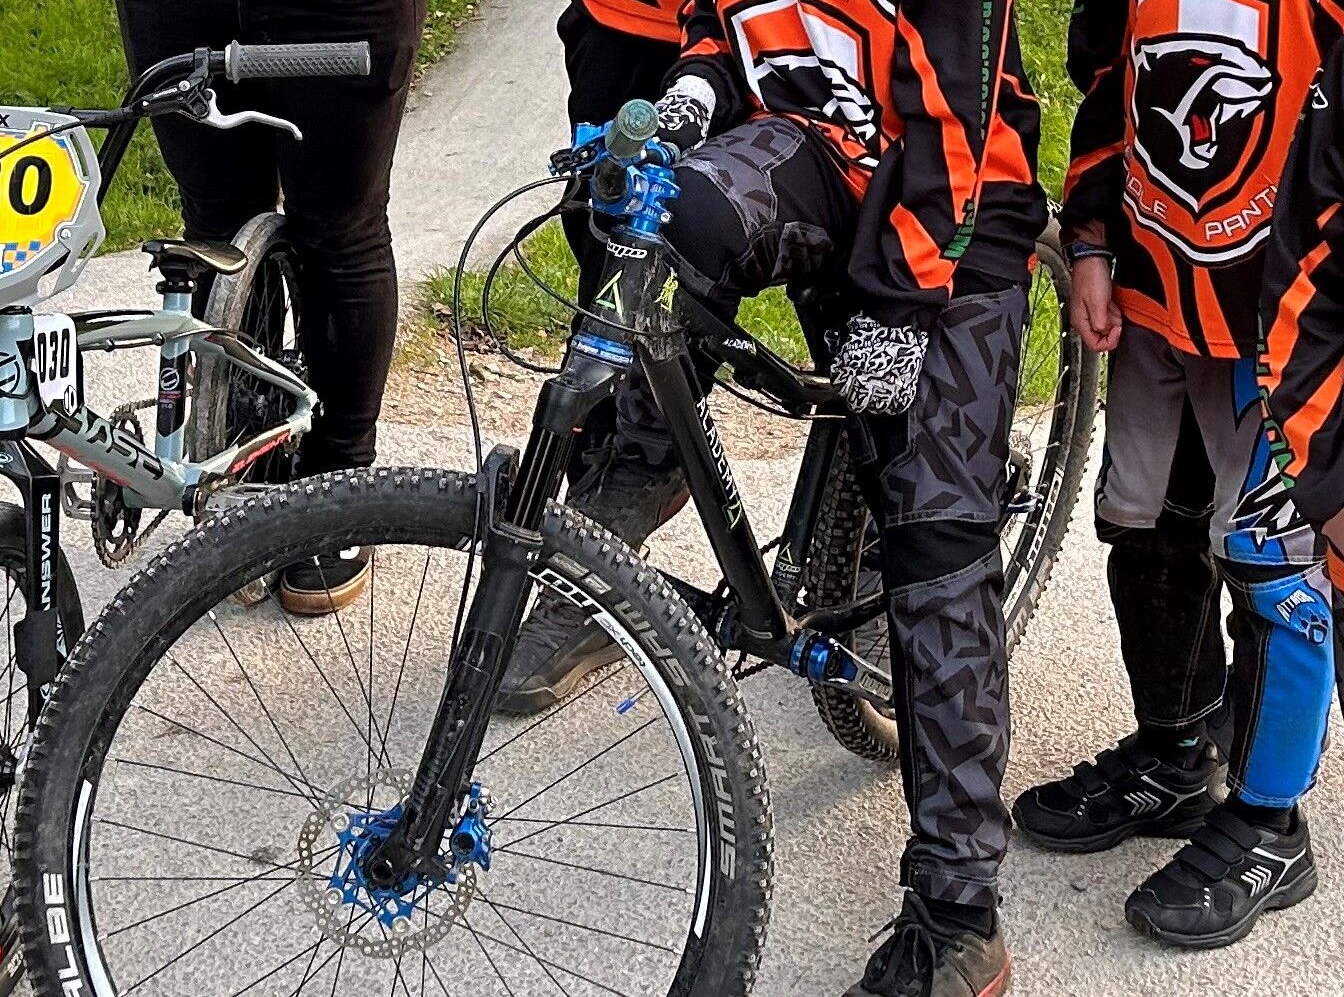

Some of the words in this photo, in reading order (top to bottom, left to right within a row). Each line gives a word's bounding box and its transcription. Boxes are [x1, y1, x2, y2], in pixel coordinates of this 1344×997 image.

[1206, 184, 1278, 241] PANT
[37, 328, 72, 384] 030
[696, 396, 739, 501] ACADEMY
[613, 600, 693, 688] SAM
[687, 705, 737, 881] SMART
